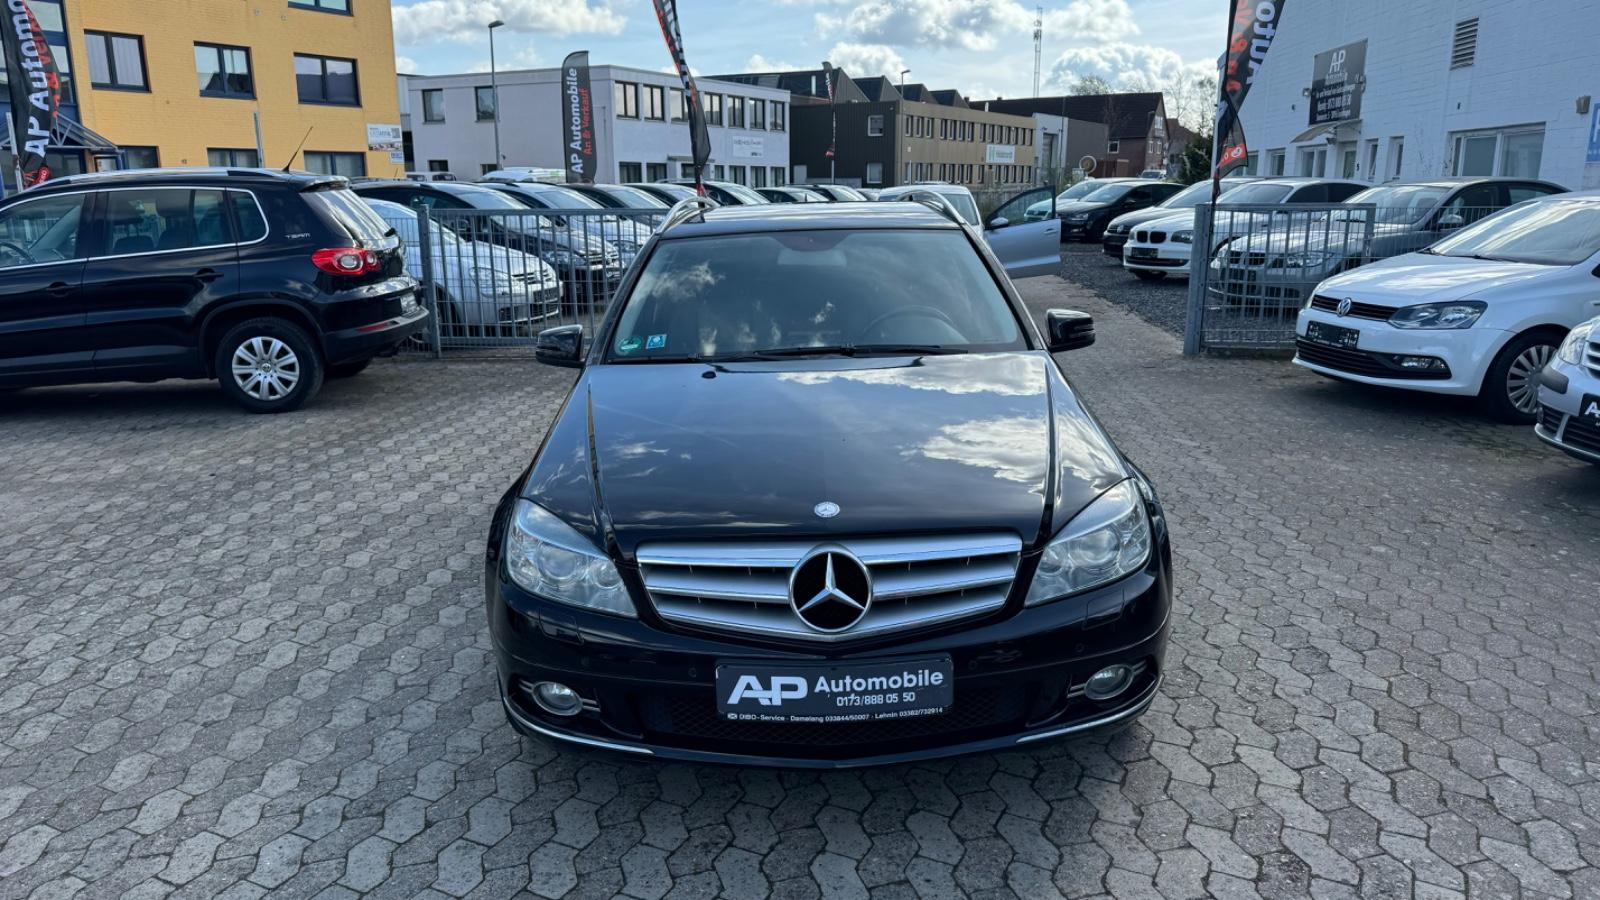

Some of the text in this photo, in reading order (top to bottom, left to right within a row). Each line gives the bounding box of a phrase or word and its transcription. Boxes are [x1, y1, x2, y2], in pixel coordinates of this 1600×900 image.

[1329, 50, 1346, 73] AP
[566, 68, 584, 173] AP Automobile
[579, 88, 590, 128] Verkauf
[24, 116, 50, 158] AP
[583, 142, 592, 155] An
[726, 670, 944, 706] AP Automobile
[836, 692, 916, 707] 0173/888 05 50
